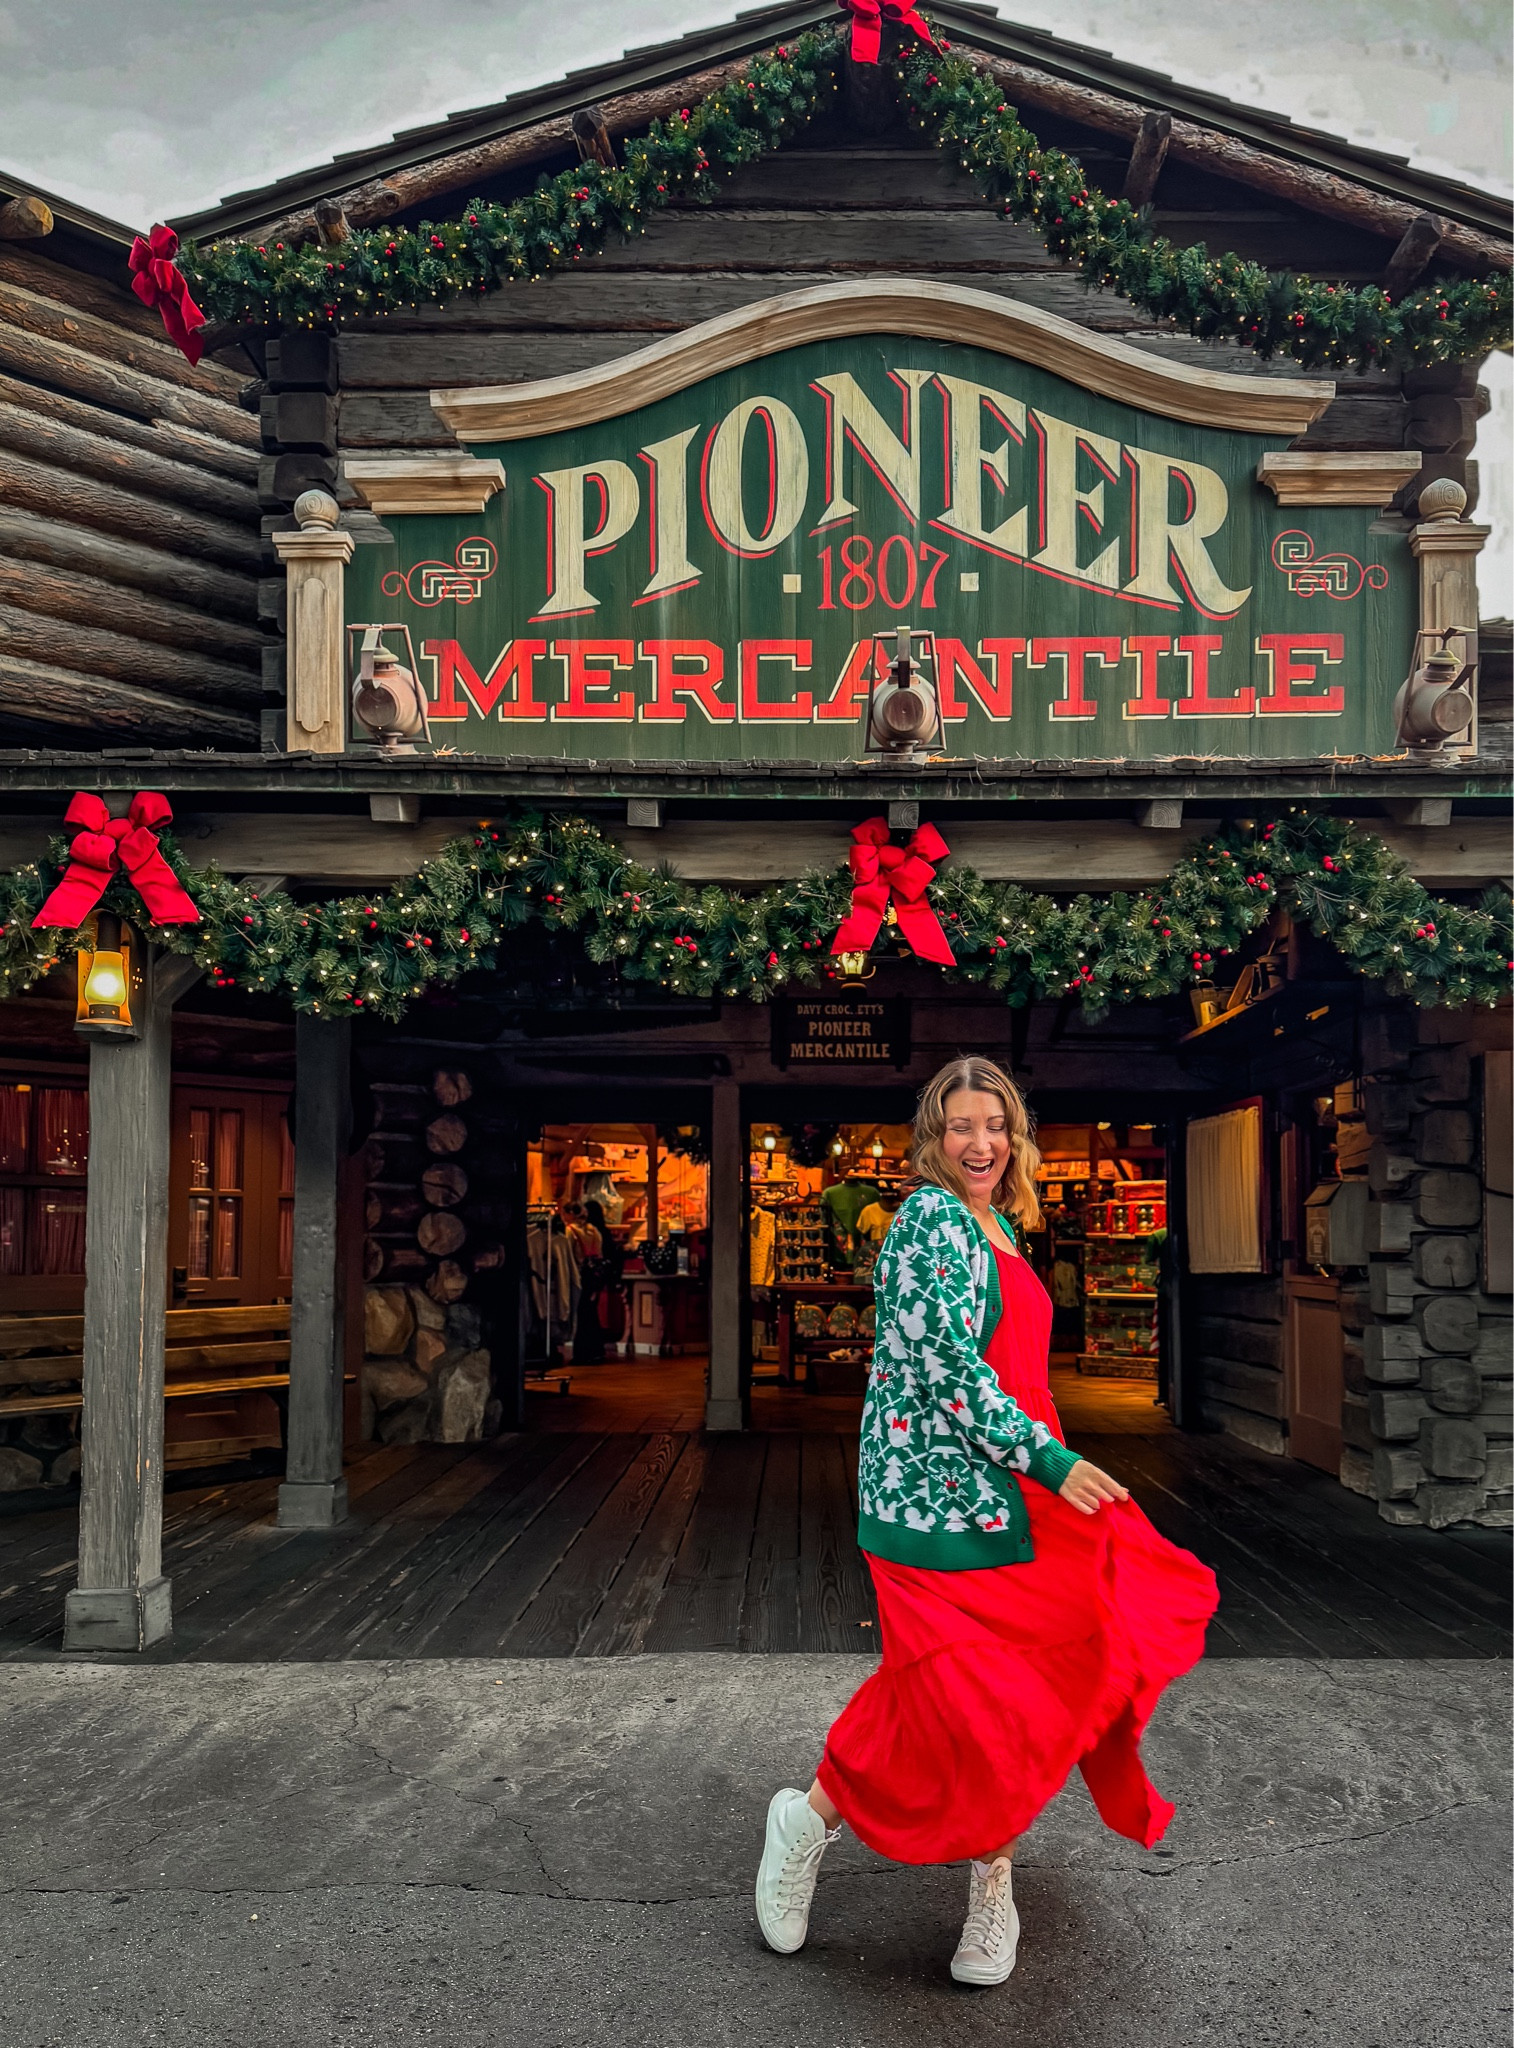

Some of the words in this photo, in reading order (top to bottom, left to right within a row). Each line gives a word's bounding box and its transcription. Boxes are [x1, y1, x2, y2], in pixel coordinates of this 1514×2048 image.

[529, 368, 1252, 622] PIONEER
[817, 535, 949, 610] 1807
[797, 1005, 821, 1015] DAVY
[824, 1004, 884, 1015] CROCETT'S
[808, 1021, 872, 1036] PIONEER
[790, 1043, 890, 1058] MERCANTILE
